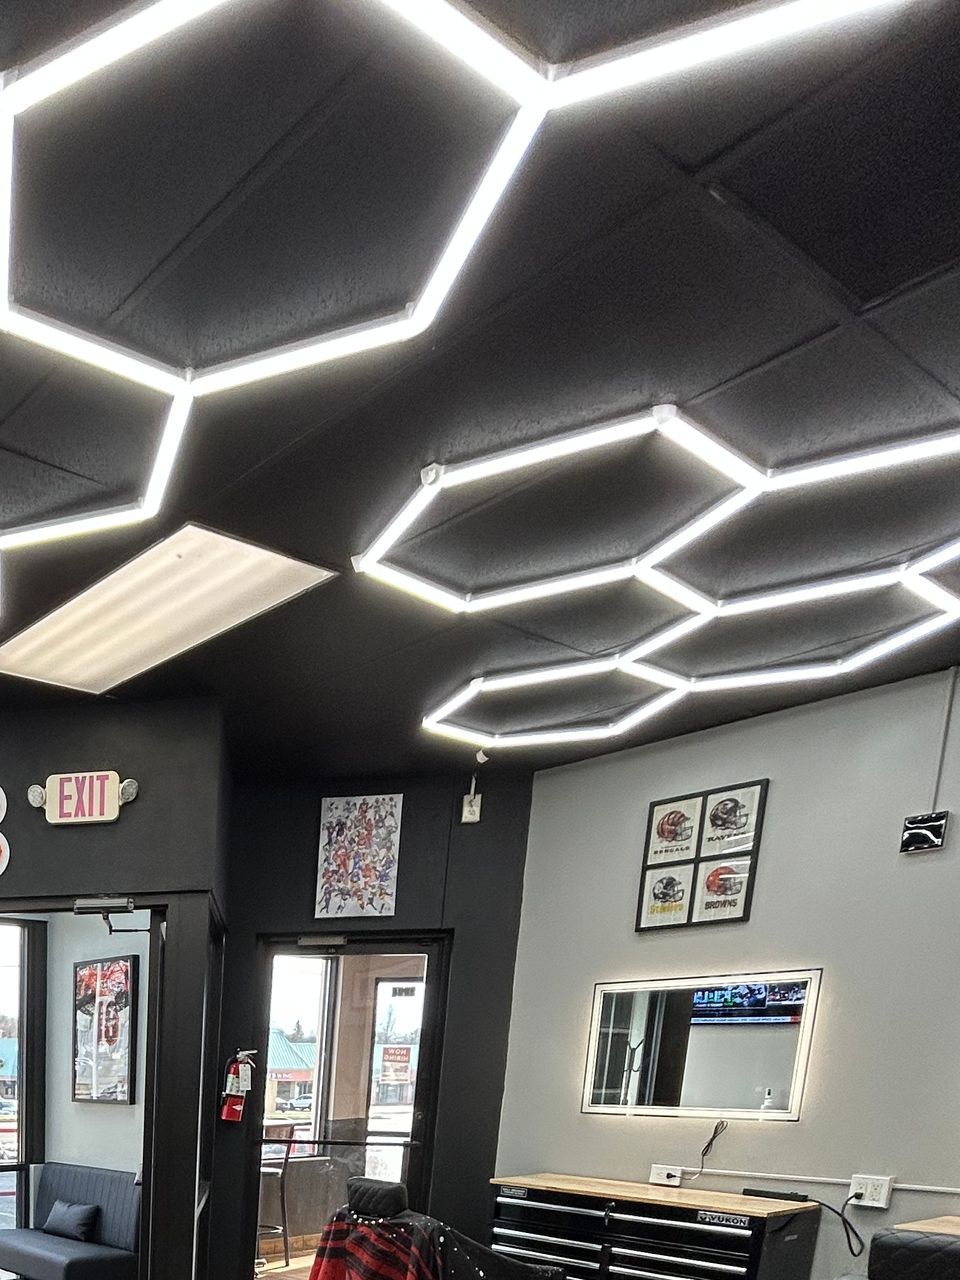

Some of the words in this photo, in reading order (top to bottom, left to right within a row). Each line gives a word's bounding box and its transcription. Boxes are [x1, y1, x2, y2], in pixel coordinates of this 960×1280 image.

[58, 774, 110, 819] EXIT
[704, 899, 738, 910] BROWNS
[709, 1214, 747, 1226] YUKON
